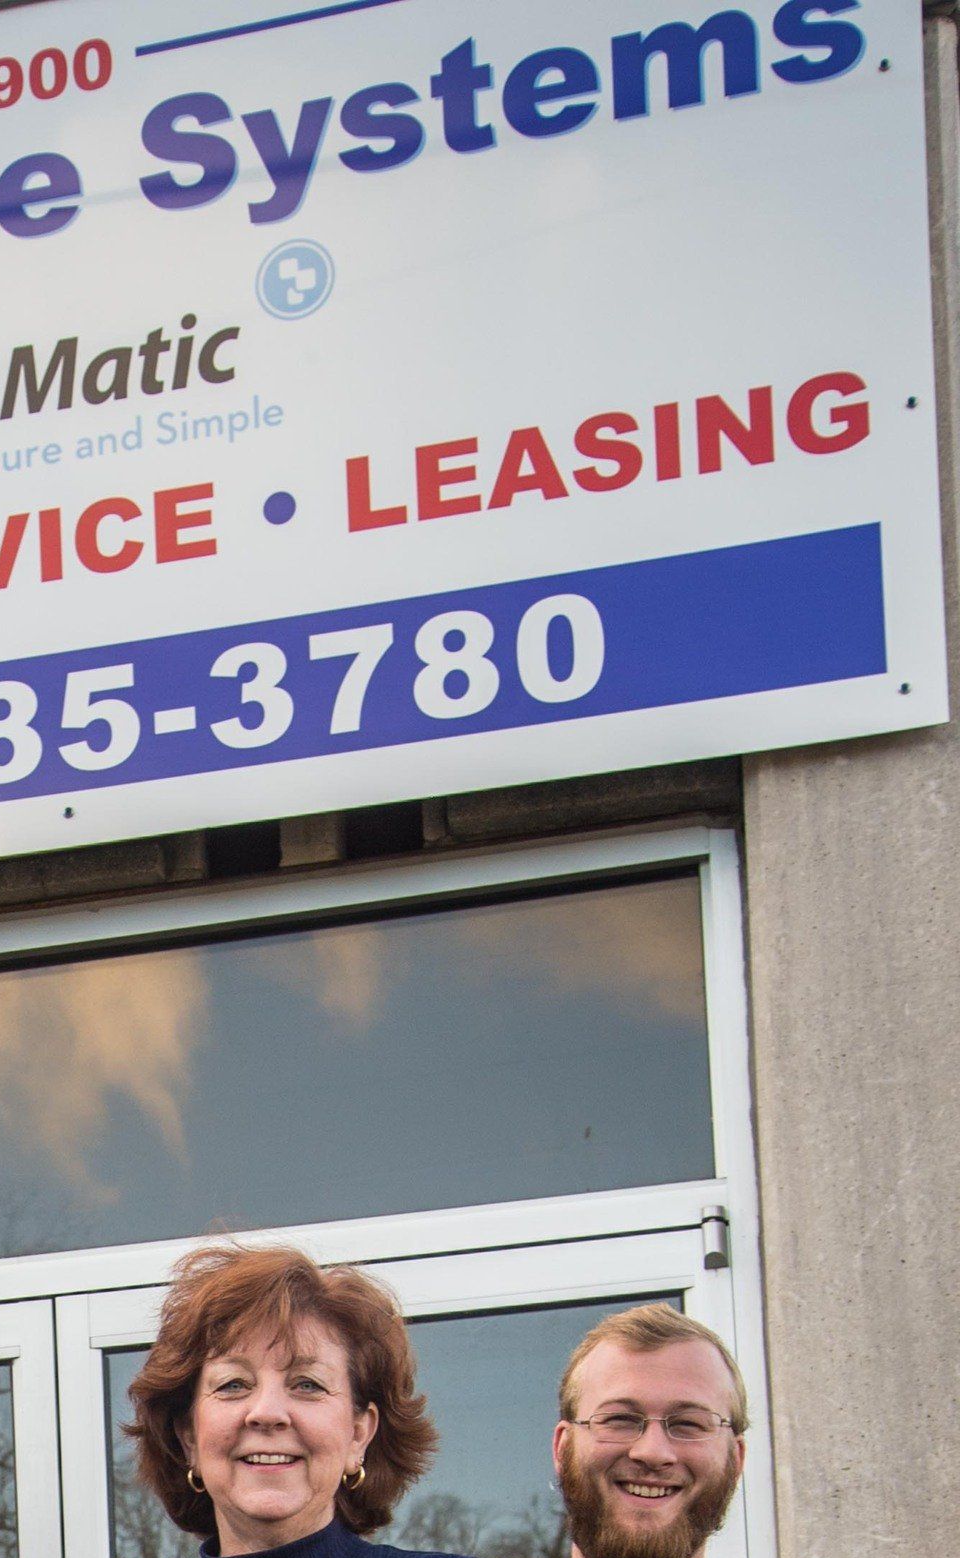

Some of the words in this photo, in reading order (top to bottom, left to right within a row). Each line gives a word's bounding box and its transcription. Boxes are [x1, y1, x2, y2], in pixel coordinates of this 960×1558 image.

[139, 0, 869, 226] Systems
[74, 416, 143, 459] and
[157, 394, 284, 446] Simple
[345, 371, 871, 533] LEASING
